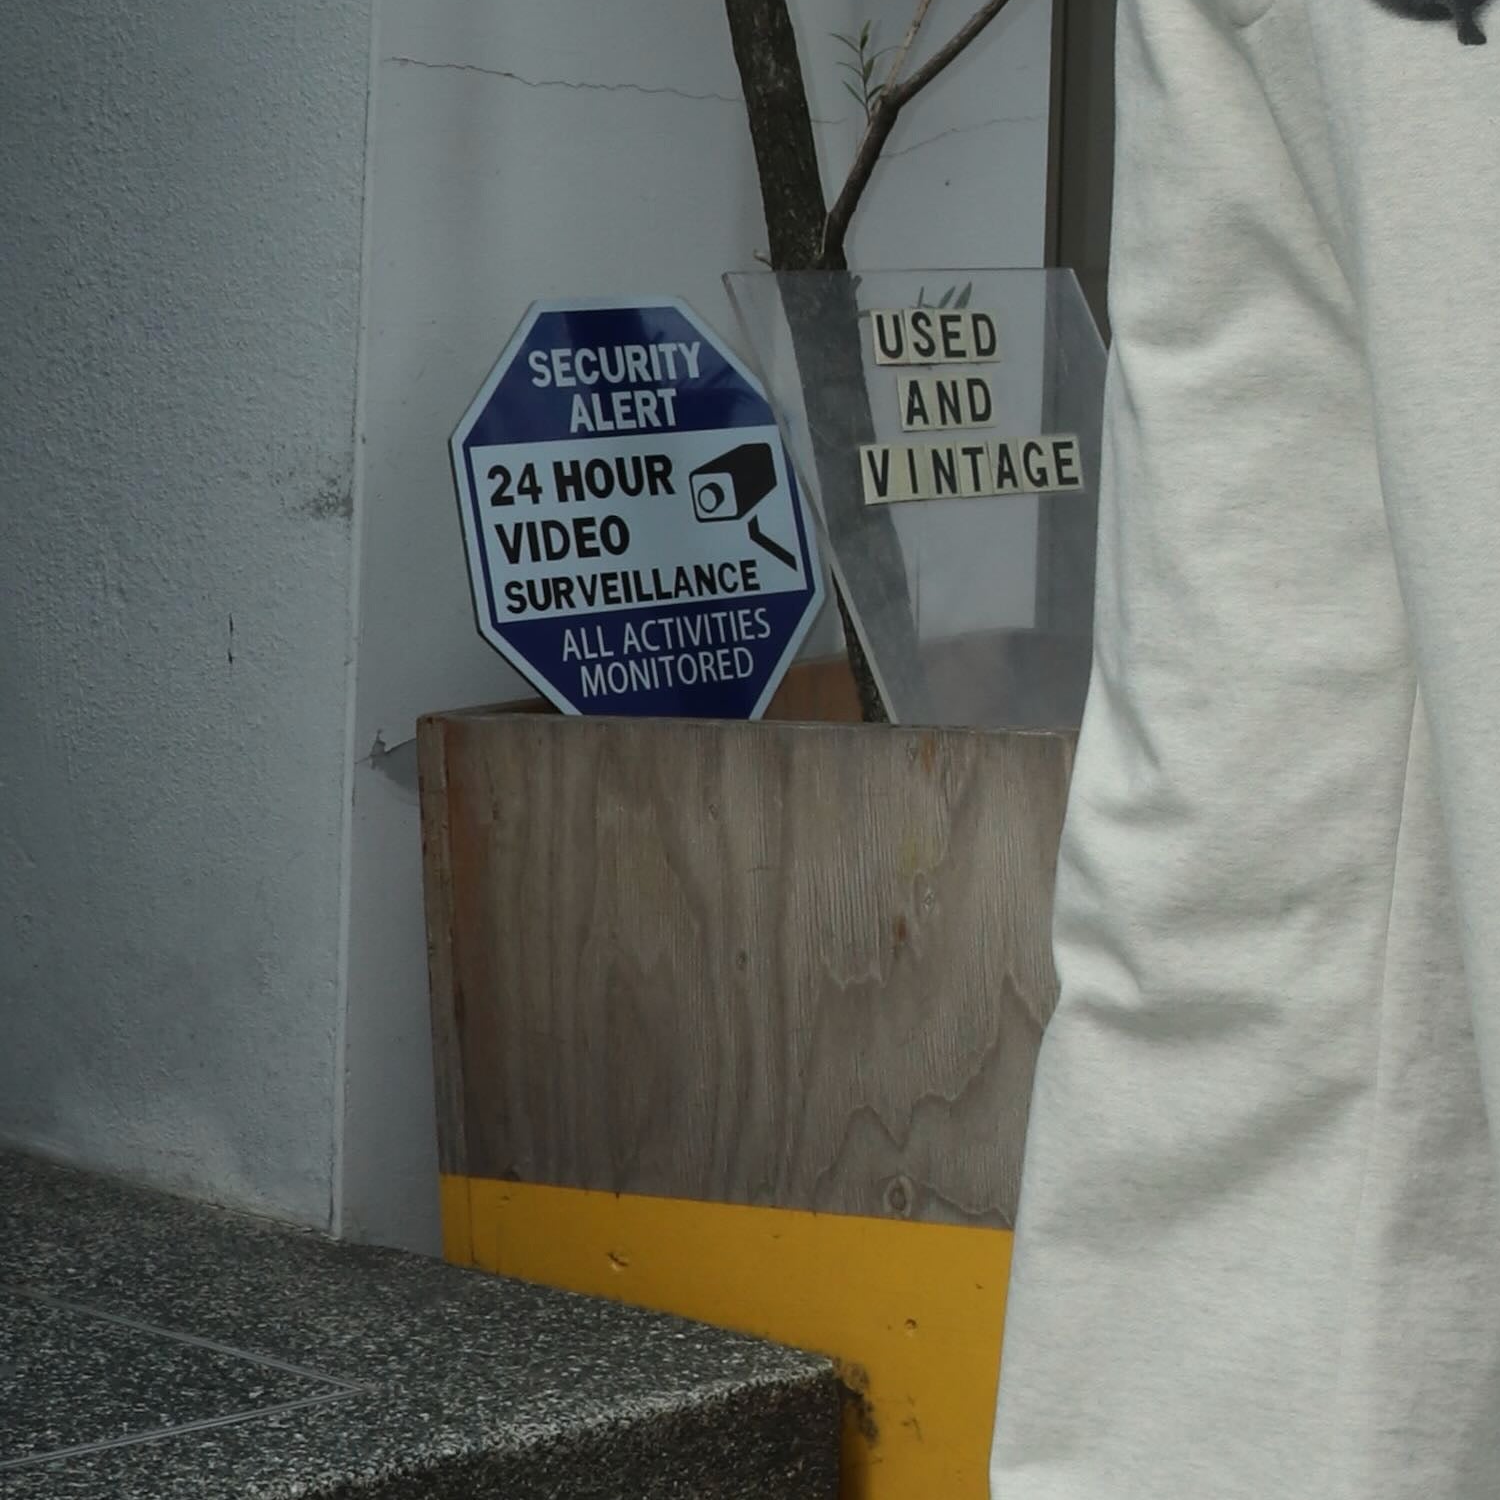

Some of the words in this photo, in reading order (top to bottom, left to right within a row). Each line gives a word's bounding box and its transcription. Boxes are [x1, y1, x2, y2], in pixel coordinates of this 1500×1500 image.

[876, 311, 997, 359] USED
[528, 341, 700, 388] SECURITY
[570, 388, 677, 434] ALERT
[906, 377, 993, 426] AND
[487, 462, 543, 507] 24
[552, 454, 676, 503] HOUR
[867, 441, 1080, 497] VINTAGE
[494, 514, 630, 565] VIDEO
[505, 559, 761, 614] SURVEILLANCE
[562, 626, 614, 662] ALL
[623, 607, 771, 655] ACTIVITIES
[579, 646, 754, 698] MONITORED
